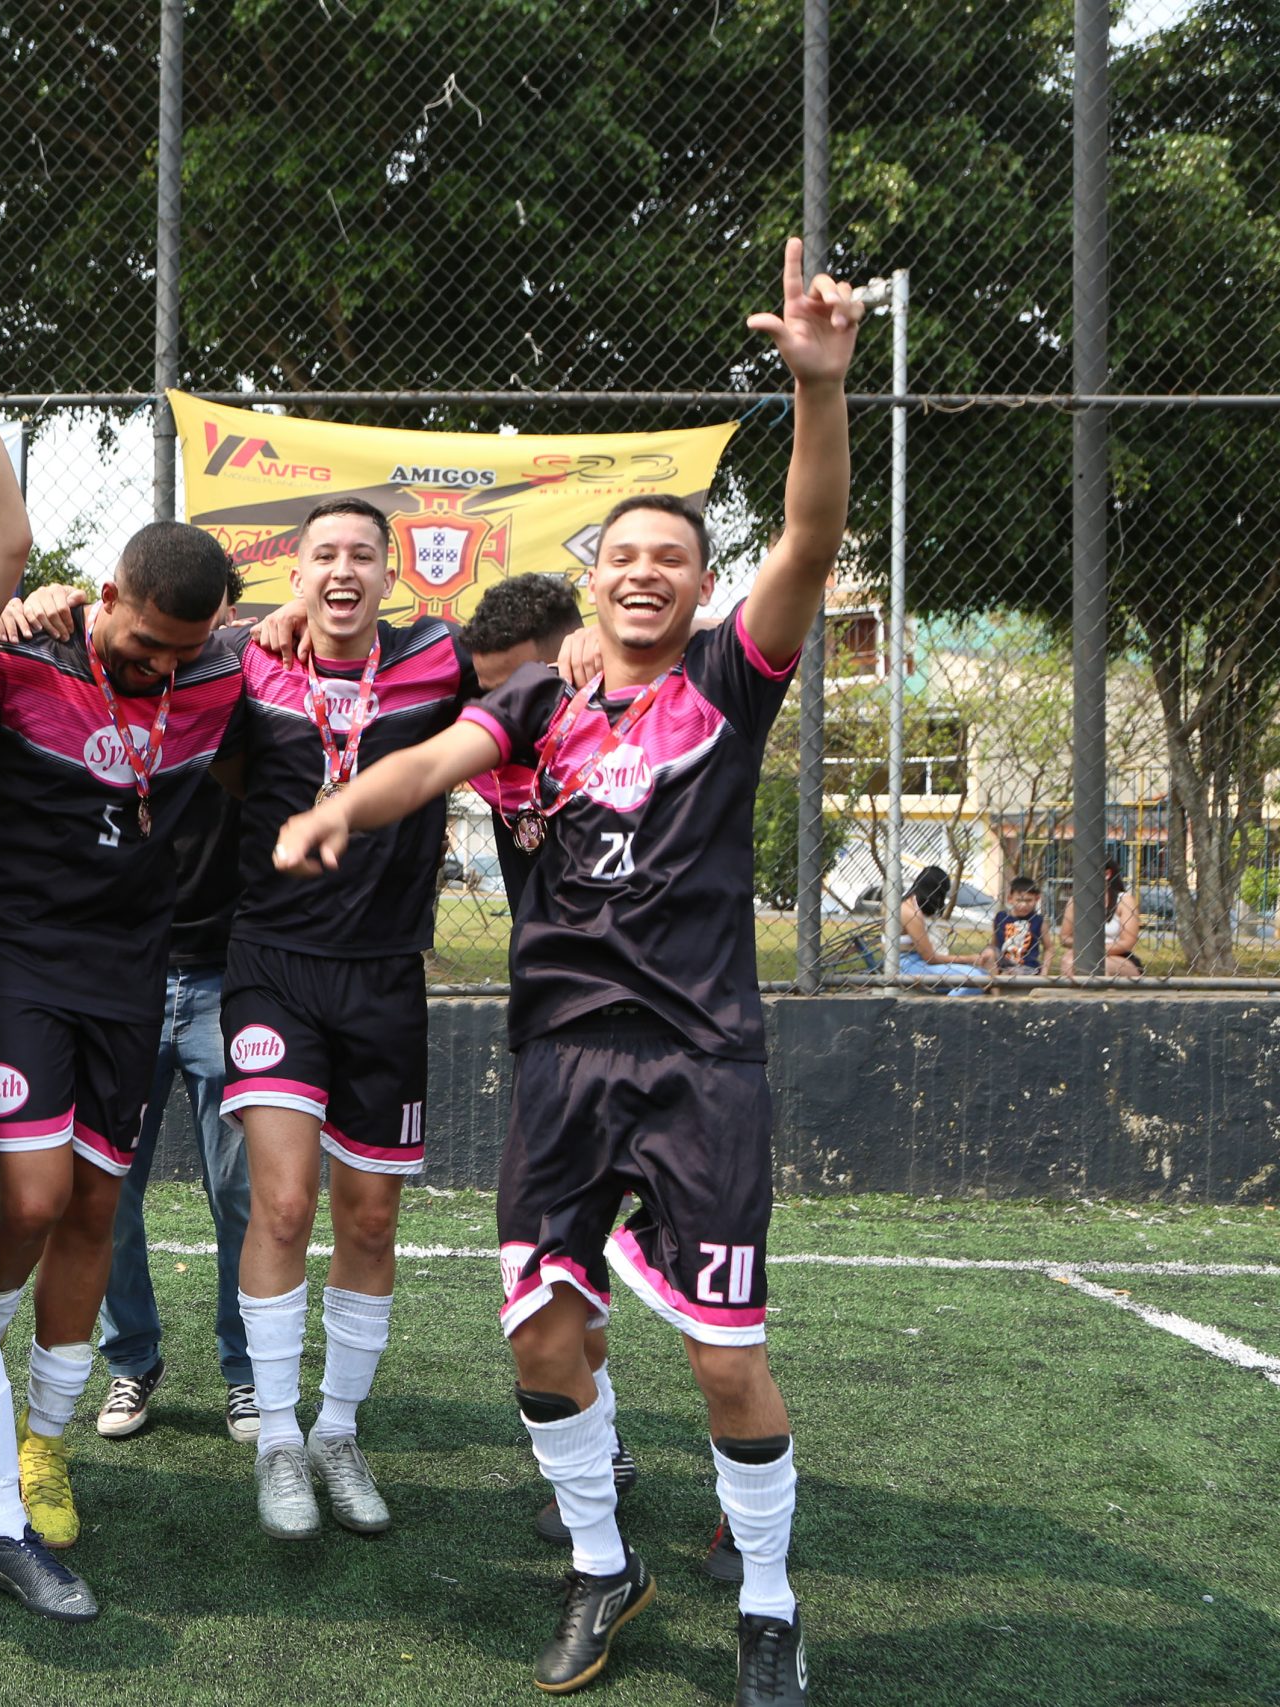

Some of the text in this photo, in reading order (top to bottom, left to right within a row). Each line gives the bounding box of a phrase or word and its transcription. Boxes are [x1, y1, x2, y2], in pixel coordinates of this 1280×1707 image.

[257, 460, 332, 482] WFG
[389, 465, 495, 486] AMIGOS
[97, 804, 123, 848] 5
[235, 1036, 281, 1065] Synth
[399, 1100, 423, 1145] 10
[696, 1241, 755, 1304] 20
